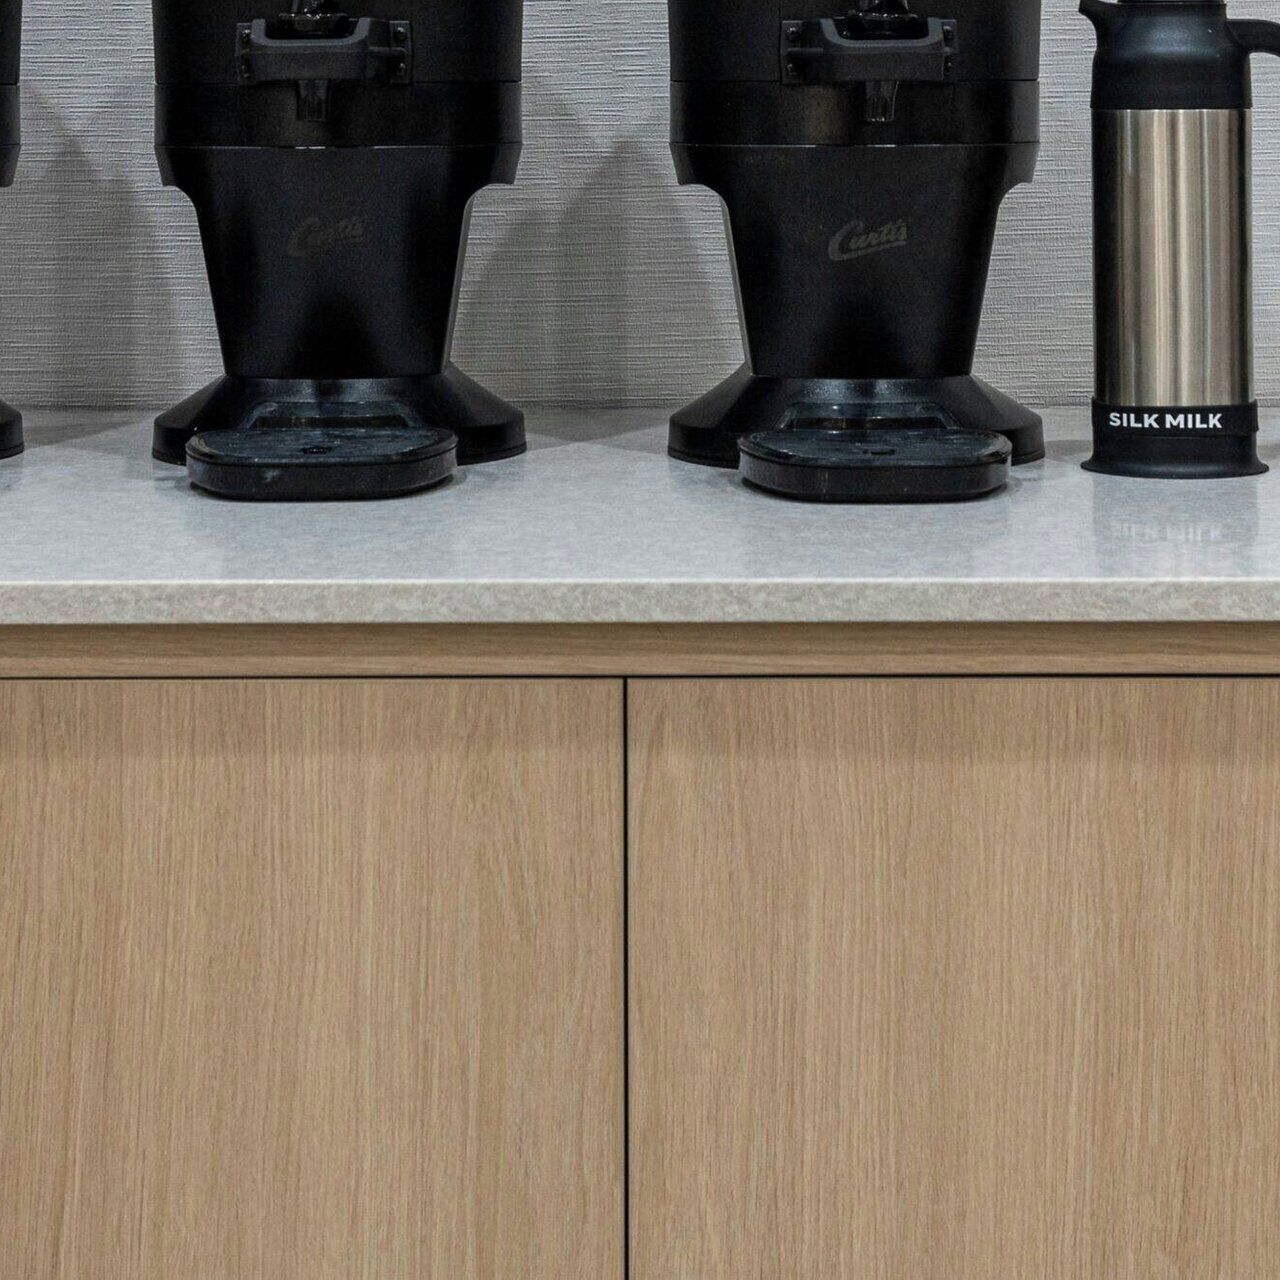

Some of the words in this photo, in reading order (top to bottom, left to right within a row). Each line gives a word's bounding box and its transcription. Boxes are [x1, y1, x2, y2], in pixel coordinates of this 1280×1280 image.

[828, 218, 909, 261] Curtis
[1109, 412, 1160, 428] SILK
[1165, 413, 1222, 428] MILK
